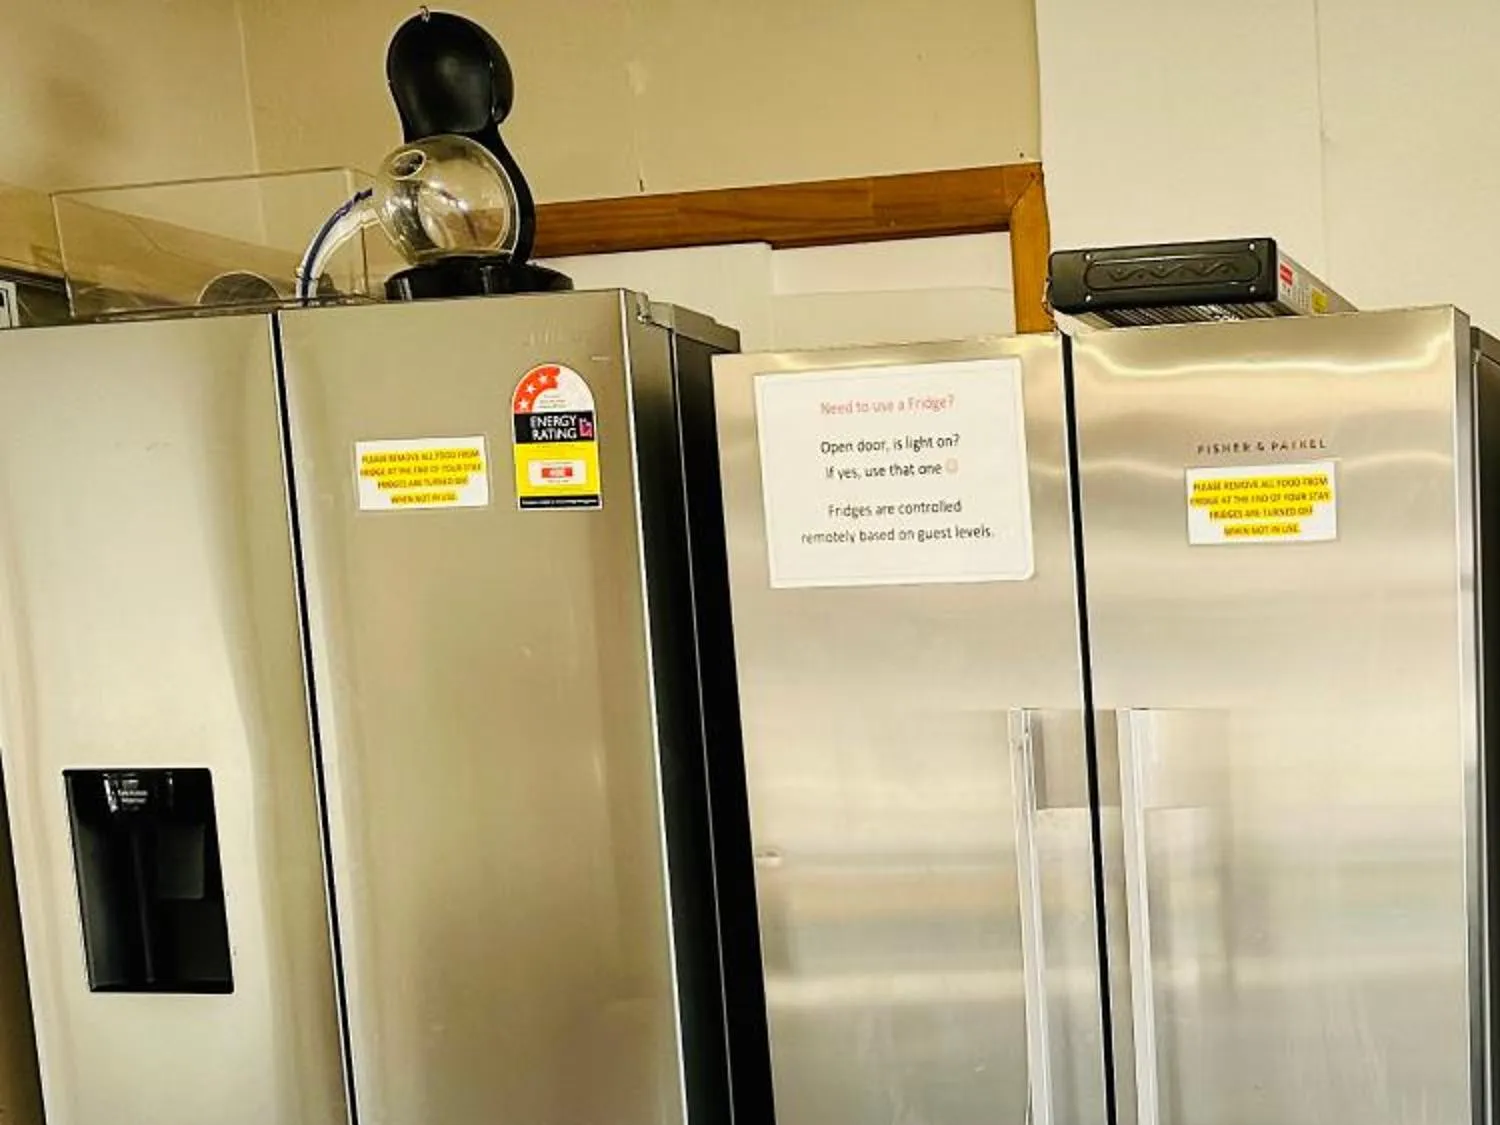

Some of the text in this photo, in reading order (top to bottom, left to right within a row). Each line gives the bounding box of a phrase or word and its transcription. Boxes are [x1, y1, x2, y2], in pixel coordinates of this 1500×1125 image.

[821, 394, 955, 415] Need to use a Fridge?
[530, 415, 577, 427] ENERGY
[532, 427, 577, 440] RATING
[821, 433, 960, 456] Open door, is light on?
[1197, 442, 1250, 454] FISHER
[1271, 439, 1328, 451] PAYKEL
[825, 463, 942, 480] If yes, use that one
[828, 500, 962, 518] Fridges are controlled
[801, 530, 855, 545] remotely
[859, 528, 894, 542] based
[898, 530, 914, 541] on
[917, 527, 952, 543] guest
